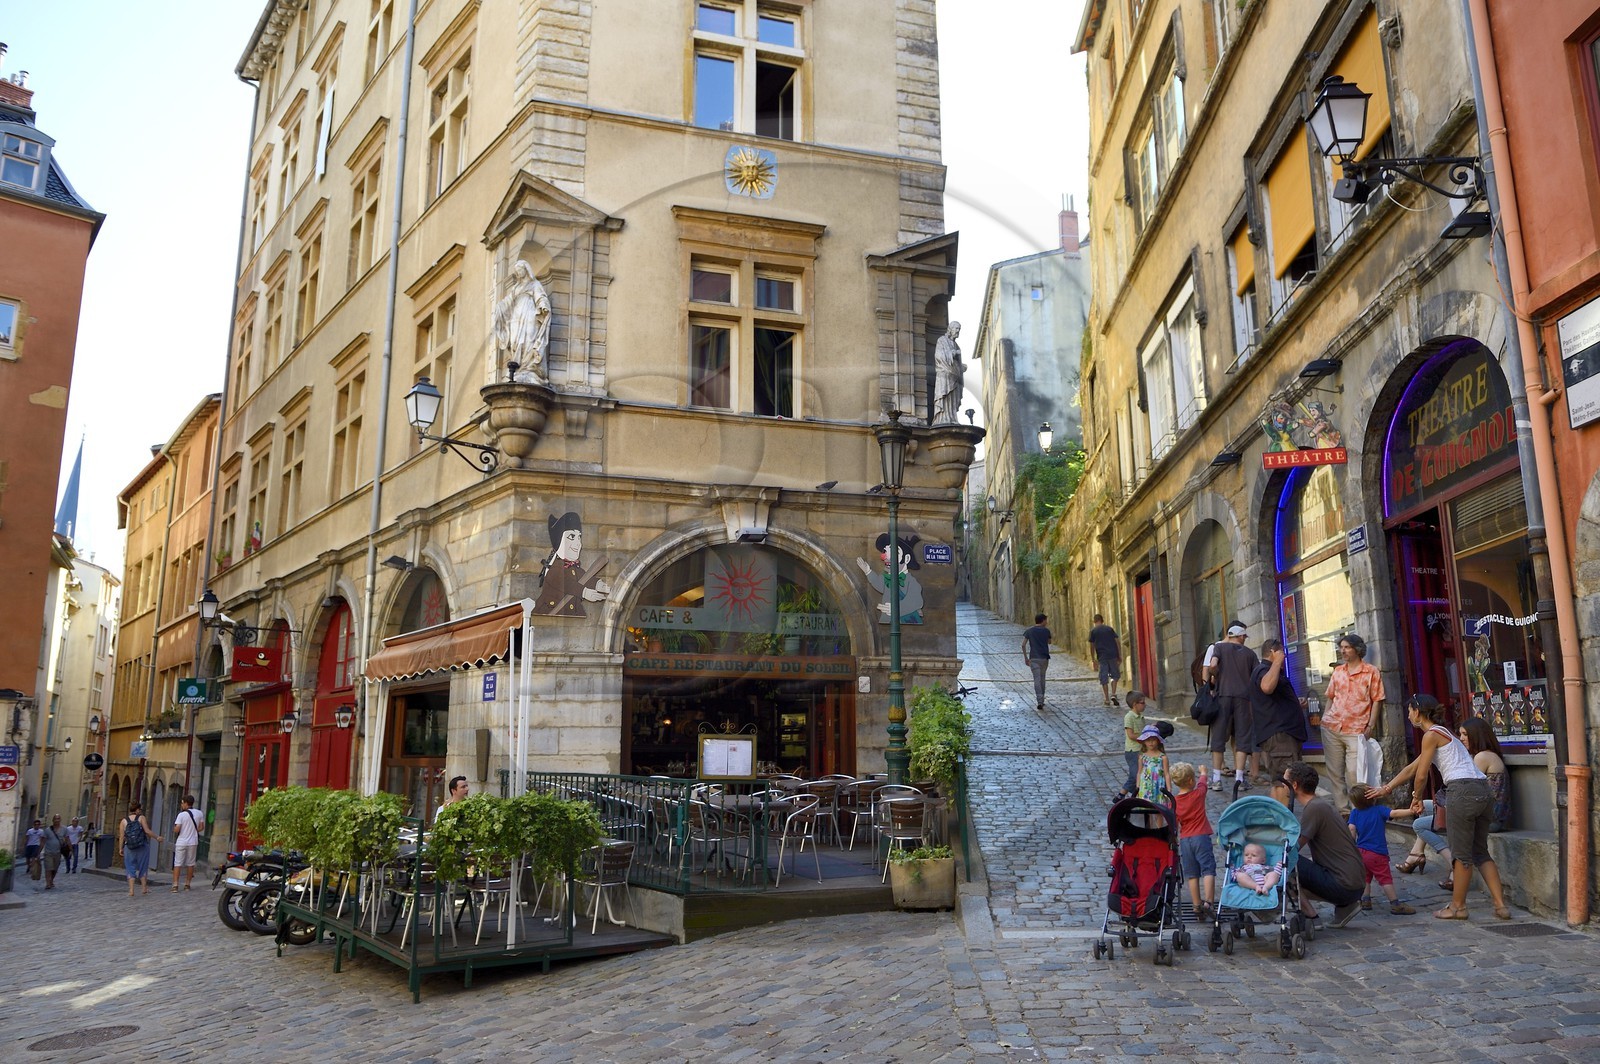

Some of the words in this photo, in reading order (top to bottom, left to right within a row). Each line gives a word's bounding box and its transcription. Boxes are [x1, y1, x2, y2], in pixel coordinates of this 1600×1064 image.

[1571, 400, 1596, 416] Saint-Jean
[1265, 450, 1345, 466] THÉÂTRE
[1391, 462, 1415, 502] DE
[1420, 404, 1518, 488] GUIGNOL
[1411, 567, 1438, 576] THEATRE
[682, 611, 693, 625] &
[1505, 616, 1515, 626] DE
[674, 658, 774, 673] RESTAURANT
[780, 661, 801, 673] DU
[805, 662, 851, 675] SOLEIL
[179, 695, 206, 704] Laverie
